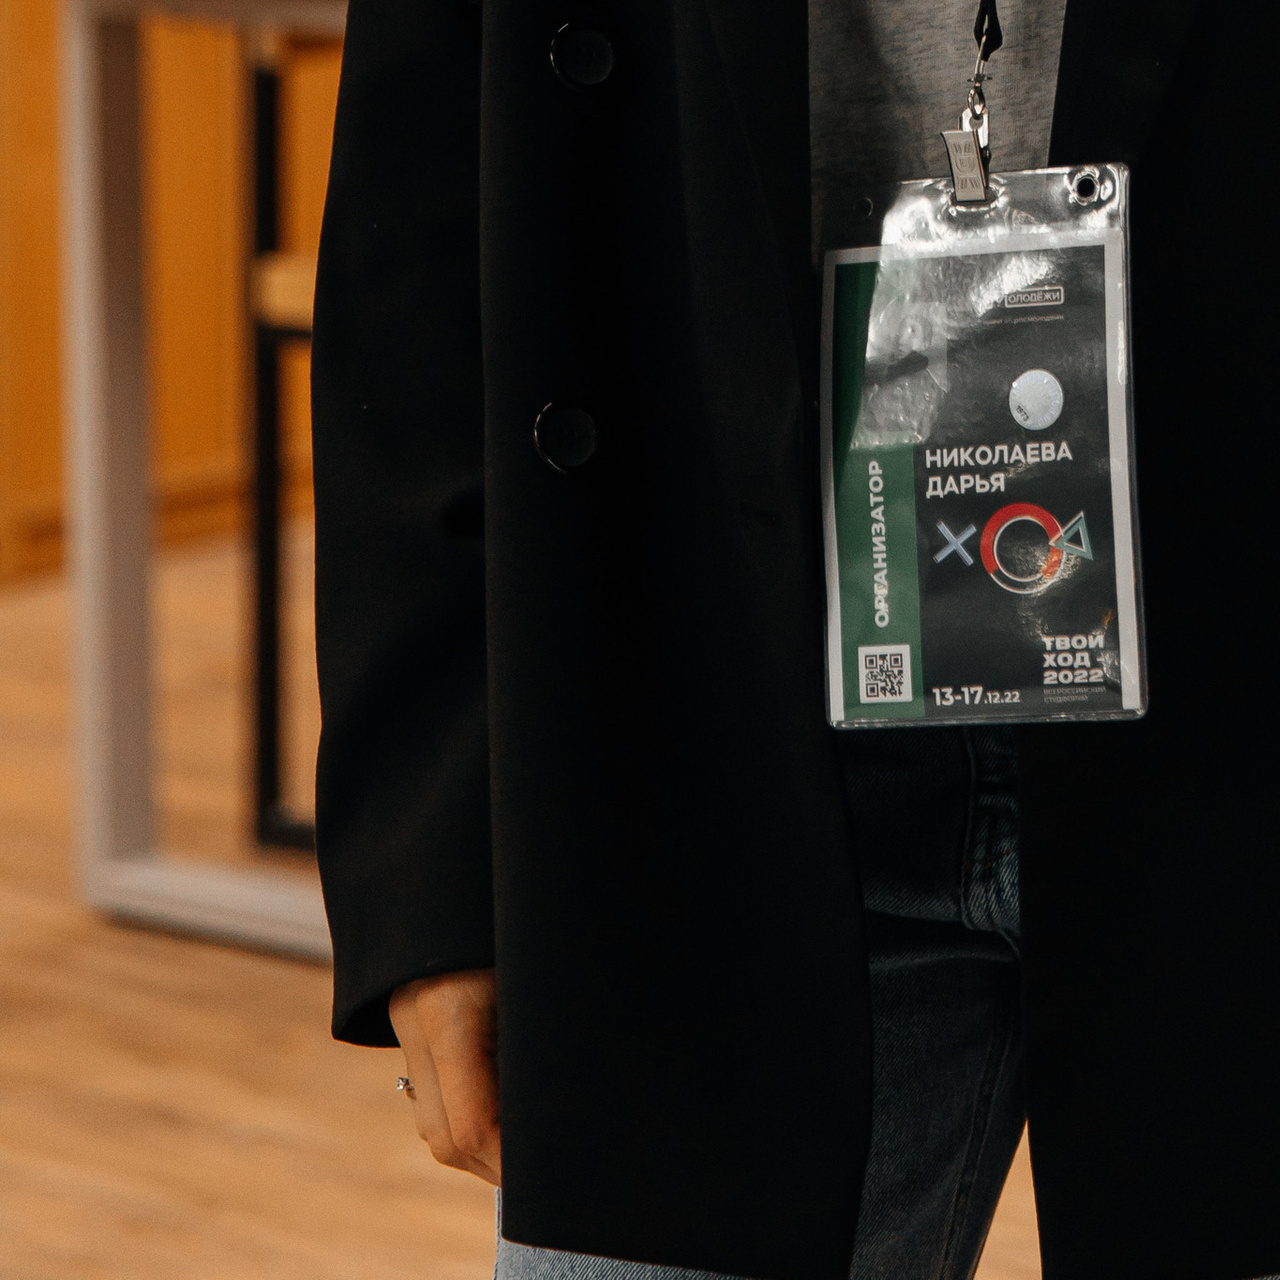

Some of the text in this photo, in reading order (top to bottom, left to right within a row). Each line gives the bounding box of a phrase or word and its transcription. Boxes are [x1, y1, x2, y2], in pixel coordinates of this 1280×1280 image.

[925, 441, 1073, 469] НИКОЛАЕВА
[925, 472, 1006, 499] ДАРЬЯ
[868, 460, 890, 628] ОРГАНИЗАТОР
[1042, 629, 1105, 651] ТВОЙ
[1042, 651, 1091, 669] ХОД
[1043, 668, 1105, 685] 2022
